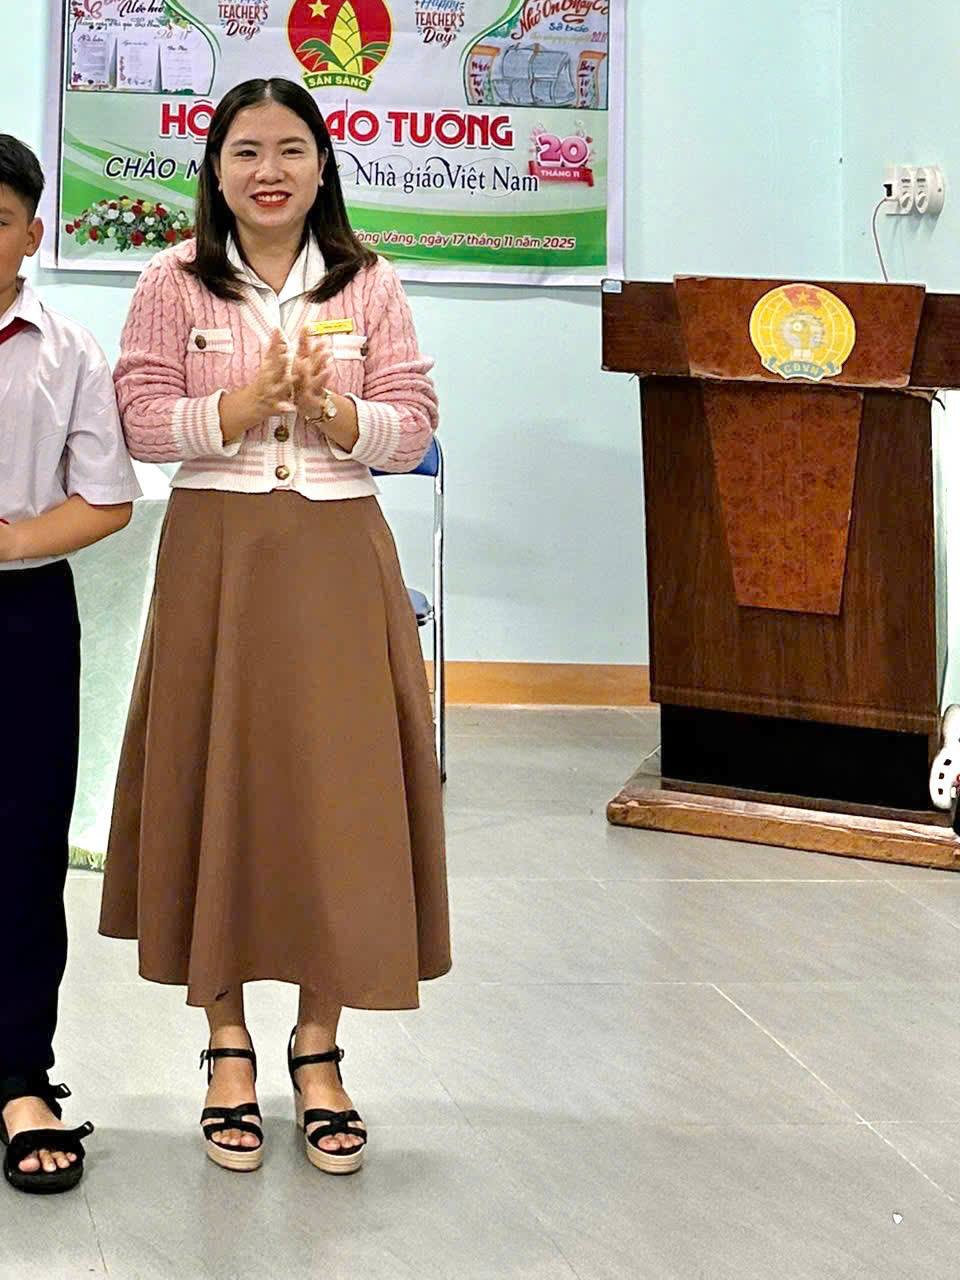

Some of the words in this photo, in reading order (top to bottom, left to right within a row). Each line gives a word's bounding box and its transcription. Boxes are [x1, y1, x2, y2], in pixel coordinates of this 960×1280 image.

[218, 4, 268, 21] TEACHER'S
[415, 11, 465, 29] TEACHER'S
[226, 19, 260, 40] Day
[423, 26, 456, 47] Day
[161, 99, 216, 141] HỘ
[325, 99, 379, 142] ÁO
[539, 135, 588, 164] 20
[106, 151, 176, 178] CHÀO
[348, 154, 396, 186] Nhà
[403, 165, 444, 194] giáo
[438, 159, 485, 195] Việt
[492, 166, 538, 192] Nam
[420, 233, 449, 247] ngày
[452, 234, 465, 245] 17
[467, 234, 501, 249] tháng
[504, 236, 513, 247] 11
[515, 236, 540, 248] năm
[543, 237, 575, 248] 2025
